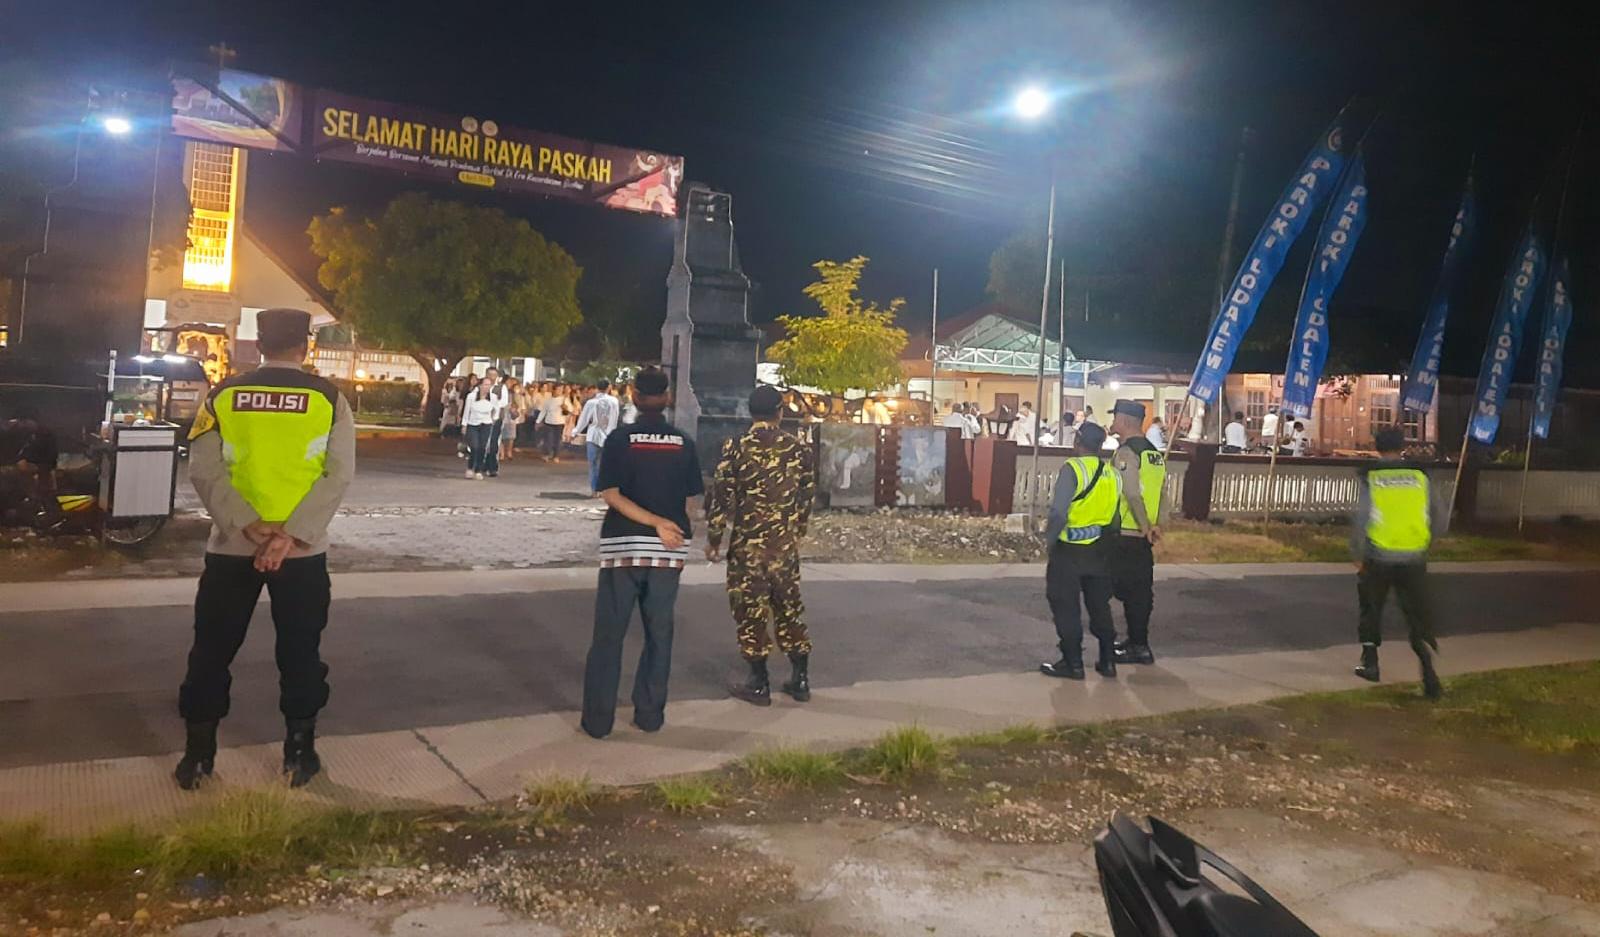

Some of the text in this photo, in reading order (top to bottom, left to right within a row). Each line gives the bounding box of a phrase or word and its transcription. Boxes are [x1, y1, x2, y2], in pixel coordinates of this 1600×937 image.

[323, 107, 612, 184] SELAMAT HARI RAYA PASKAH
[1264, 156, 1330, 248] PAROKI
[1321, 185, 1368, 272] PAROKI
[236, 392, 304, 410] POLISI
